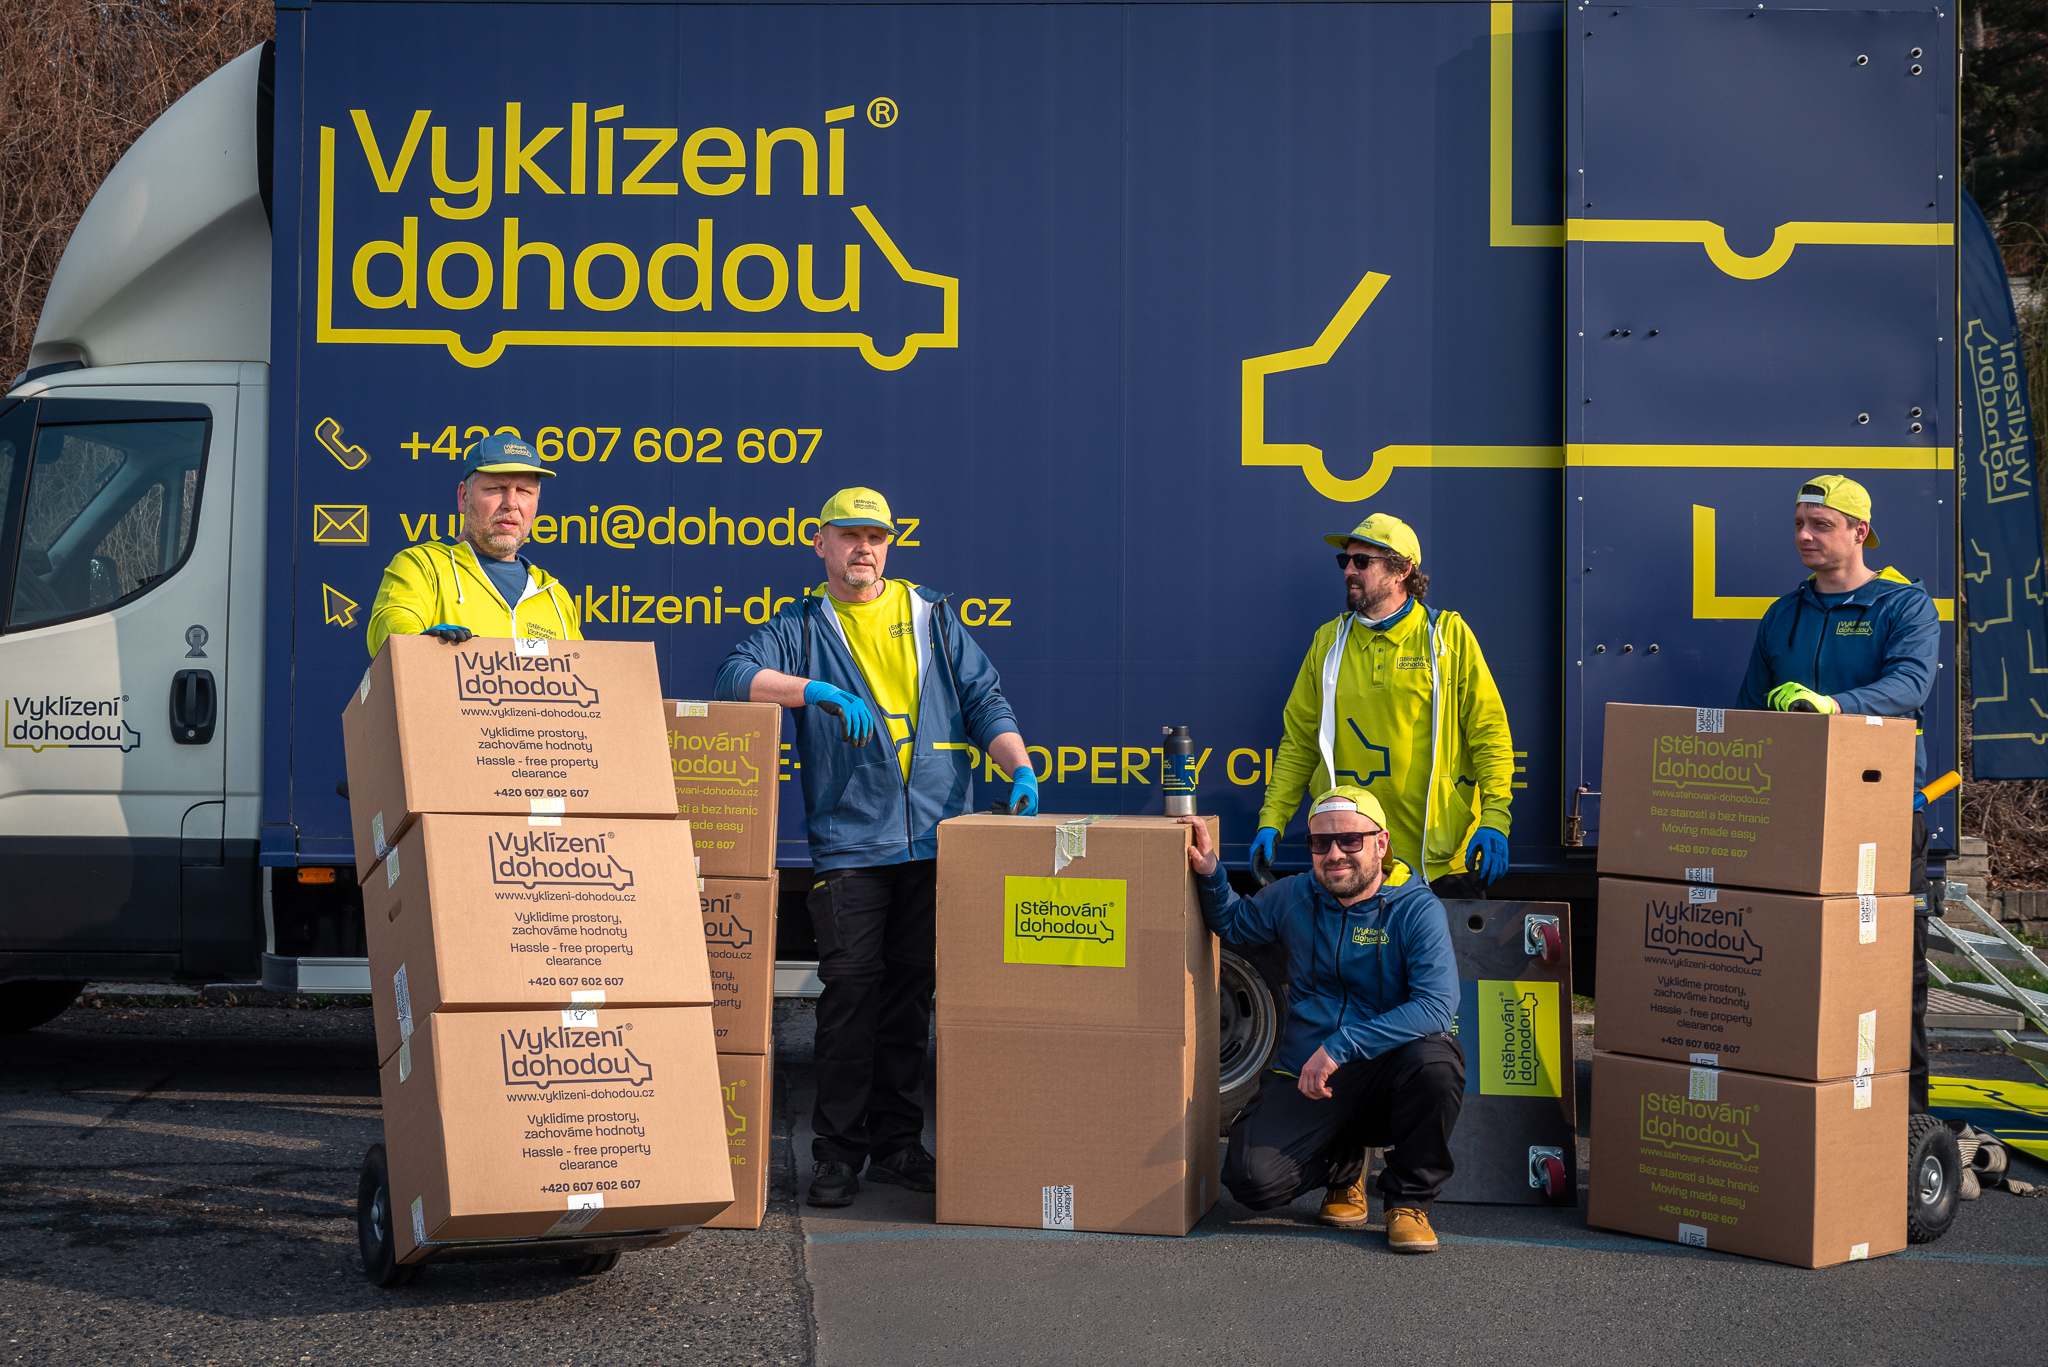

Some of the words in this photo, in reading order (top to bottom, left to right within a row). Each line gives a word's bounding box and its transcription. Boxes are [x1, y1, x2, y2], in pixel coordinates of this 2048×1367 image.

[349, 102, 855, 220] Vyklízení
[351, 216, 861, 313] dohodou
[536, 427, 622, 462] 607
[633, 428, 723, 463] 602
[737, 428, 823, 464] 607
[466, 674, 577, 696] dohodou
[13, 696, 120, 720] Vyklízení
[461, 708, 601, 718] www.vyklizeni-dohodou.cz
[13, 720, 121, 741] dohodou
[537, 729, 587, 740] prostory,
[546, 740, 592, 753] hodnoty
[477, 756, 515, 765] Hassle
[525, 756, 547, 766] free
[550, 758, 598, 769] property
[1659, 757, 1751, 781] dohodou
[512, 768, 567, 778] clearance
[494, 789, 522, 797] +420
[525, 789, 544, 797] 607
[547, 789, 567, 797] 602
[570, 789, 589, 797] 607
[702, 804, 722, 815] bez
[725, 805, 759, 816] hranic
[1651, 806, 1669, 816] Bez
[1718, 811, 1736, 821] bez
[1739, 813, 1770, 824] hranic
[716, 823, 744, 834] easy
[1662, 824, 1699, 837] Moving
[1701, 828, 1729, 837] made
[1731, 831, 1756, 842] easy
[495, 831, 605, 857] Vyklízení
[695, 840, 715, 849] 602
[717, 841, 736, 850] 607
[1694, 846, 1710, 854] 607
[1712, 848, 1729, 856] 602
[1731, 849, 1748, 857] 607
[500, 856, 612, 878] dohodou
[495, 891, 636, 902] www.vyklizeni-dohodou.cz
[1020, 901, 1108, 918] Stěhování
[514, 912, 569, 924] Vyklidíme
[572, 913, 622, 925] prostory,
[512, 925, 577, 935] zachováme
[580, 926, 627, 938] hodnoty
[1020, 918, 1097, 935] dohodou
[1651, 923, 1745, 952] dohodou
[511, 942, 549, 952] Hassle
[559, 942, 582, 952] free
[585, 944, 633, 955] property
[546, 956, 601, 965] clearance
[528, 977, 556, 986] +420
[559, 977, 578, 986] 607
[581, 977, 602, 986] 602
[605, 977, 623, 986] 607
[1704, 983, 1747, 996] prostory,
[1710, 994, 1750, 1010] hodnoty
[1651, 1003, 1682, 1015] Hassle
[1690, 1008, 1709, 1018] free
[1711, 1013, 1753, 1026] property
[714, 1029, 729, 1037] 07
[1677, 1019, 1724, 1032] clearance
[507, 1025, 623, 1055] Vyklízení
[1502, 997, 1515, 1081] Stěhování
[1518, 1008, 1531, 1081] dohodou
[1661, 1037, 1684, 1045] +420
[1686, 1039, 1703, 1048] 607
[1704, 1042, 1722, 1051] 602
[1723, 1044, 1741, 1053] 607
[512, 1052, 630, 1077] dohodou
[507, 1088, 655, 1103] www.vyklizeni-dohodou.cz
[527, 1113, 584, 1127] Vyklidíme
[587, 1112, 639, 1125] prostory,
[524, 1127, 593, 1139] zachováme
[596, 1125, 645, 1137] hodnoty
[1647, 1116, 1740, 1148] dohodou
[523, 1146, 563, 1158] Hassle
[574, 1145, 597, 1155] free
[600, 1143, 651, 1157] property
[560, 1159, 617, 1170] clearance
[1640, 1164, 1657, 1175] Bez
[1707, 1175, 1725, 1187] bez
[1728, 1179, 1759, 1192] hranic
[540, 1183, 570, 1193] +420
[573, 1182, 593, 1191] 607
[596, 1181, 618, 1190] 602
[621, 1180, 640, 1189] 607
[1652, 1182, 1688, 1199] Moving
[1690, 1191, 1718, 1202] made
[1721, 1196, 1746, 1209] easy
[1659, 1205, 1681, 1214] +420
[1684, 1209, 1700, 1217] 607
[1702, 1212, 1719, 1221] 602
[1721, 1215, 1739, 1224] 607
